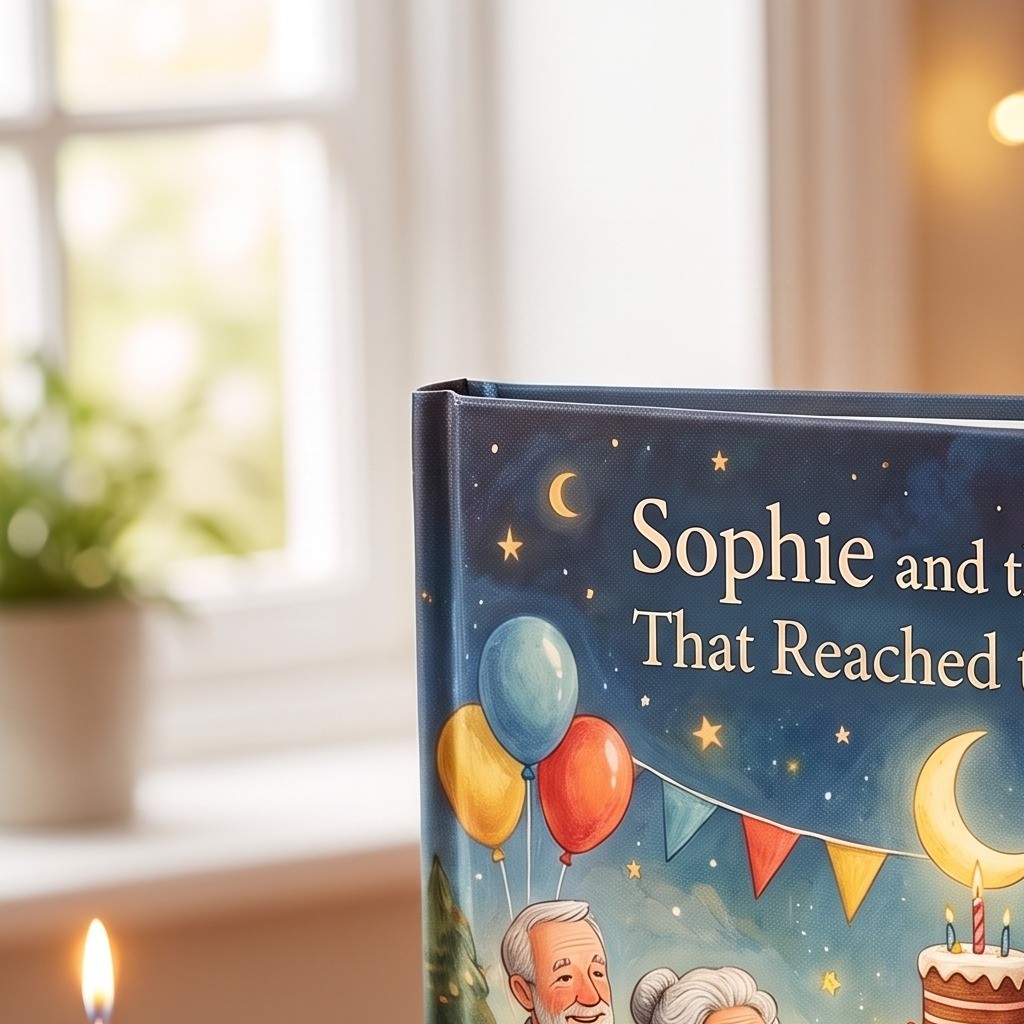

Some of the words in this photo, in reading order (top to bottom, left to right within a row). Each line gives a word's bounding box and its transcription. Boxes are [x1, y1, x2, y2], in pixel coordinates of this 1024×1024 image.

[632, 498, 874, 605] Sophie
[895, 537, 990, 595] and
[632, 607, 756, 673] That
[771, 619, 1002, 690] Reached
